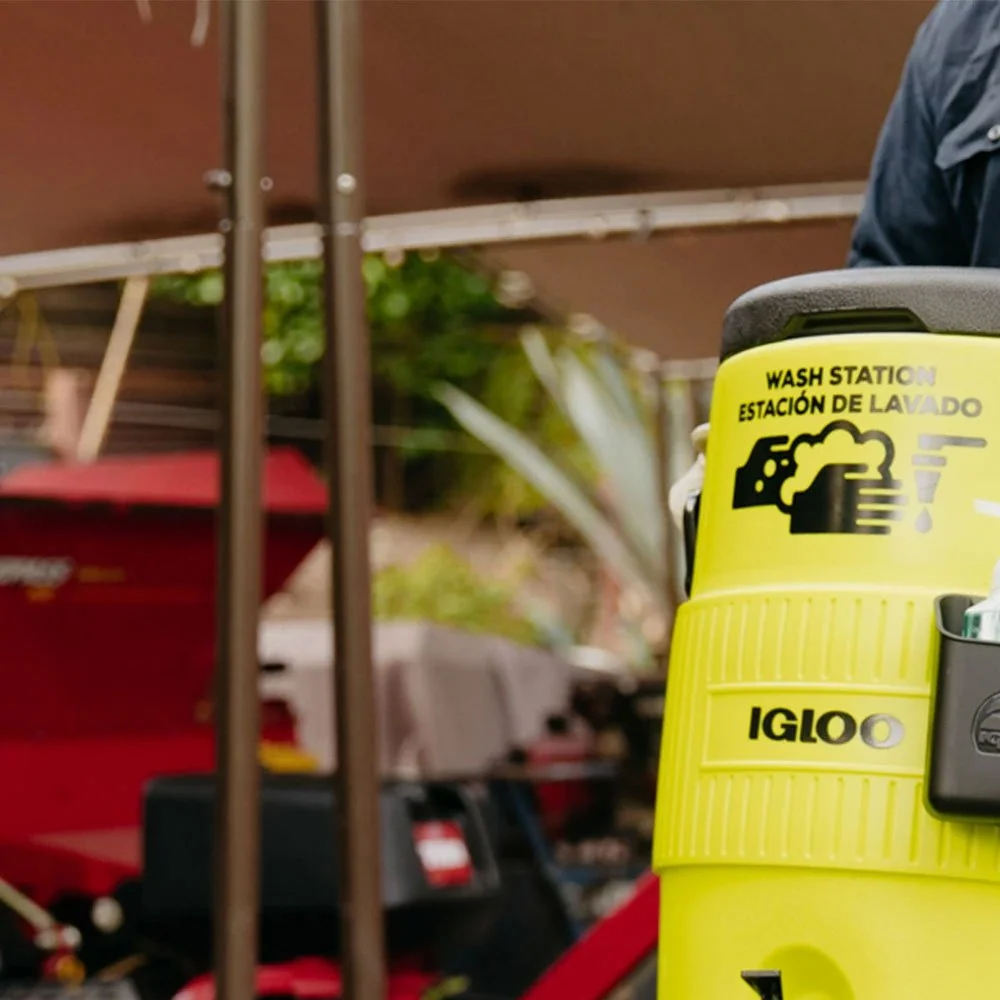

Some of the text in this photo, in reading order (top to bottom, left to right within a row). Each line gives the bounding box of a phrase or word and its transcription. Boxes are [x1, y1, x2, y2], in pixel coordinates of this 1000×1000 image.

[766, 365, 936, 389] WASH STATION
[738, 391, 982, 422] ESTACIÓN DE LAVADO
[748, 706, 906, 749] IGLOO
